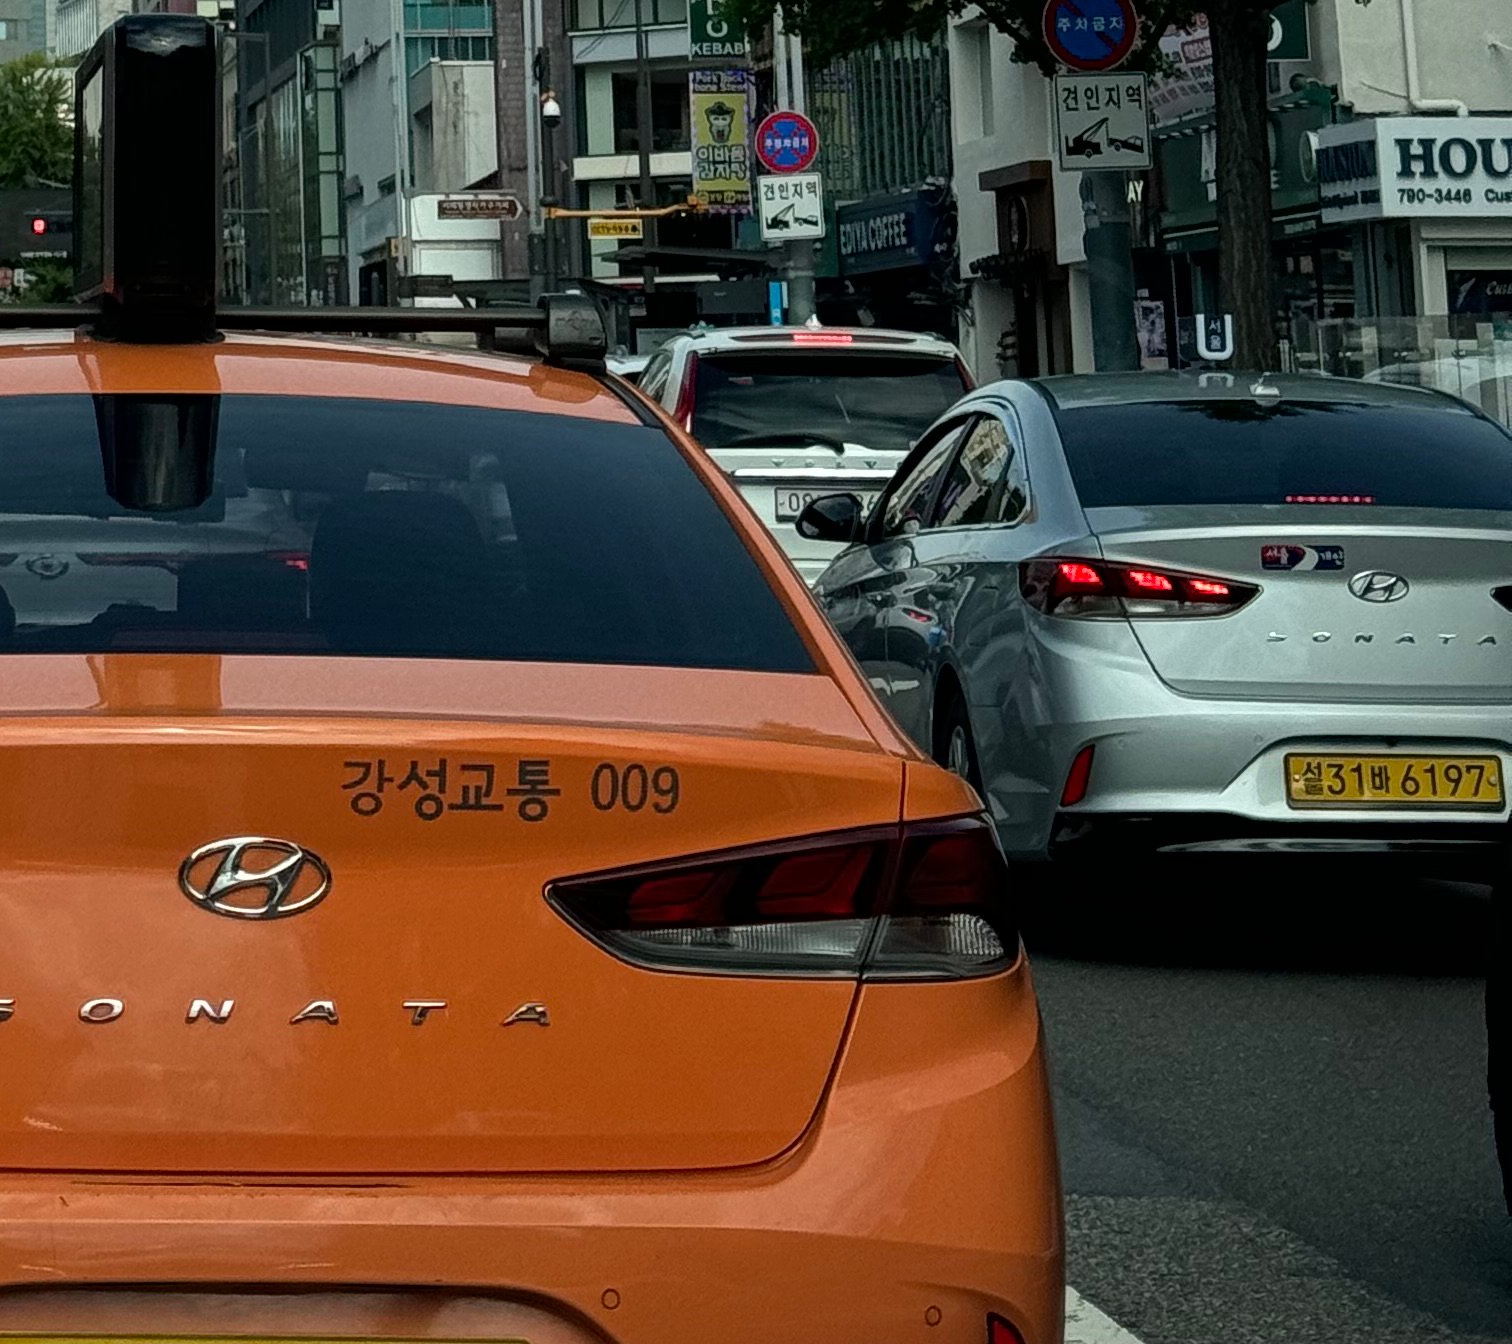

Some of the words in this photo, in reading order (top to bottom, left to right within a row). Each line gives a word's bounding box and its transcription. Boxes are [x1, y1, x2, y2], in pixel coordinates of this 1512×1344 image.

[1057, 16, 1124, 33] 주차금지
[691, 42, 745, 56] KEBAB
[1062, 84, 1143, 112] 견인지역
[763, 180, 818, 201] 견인지역
[839, 220, 868, 256] EDIYA
[868, 213, 908, 251] COFFEE
[1267, 631, 1497, 645] SONATA
[341, 758, 561, 822] 강성교통
[590, 762, 680, 814] 009
[1401, 763, 1485, 797] 6197
